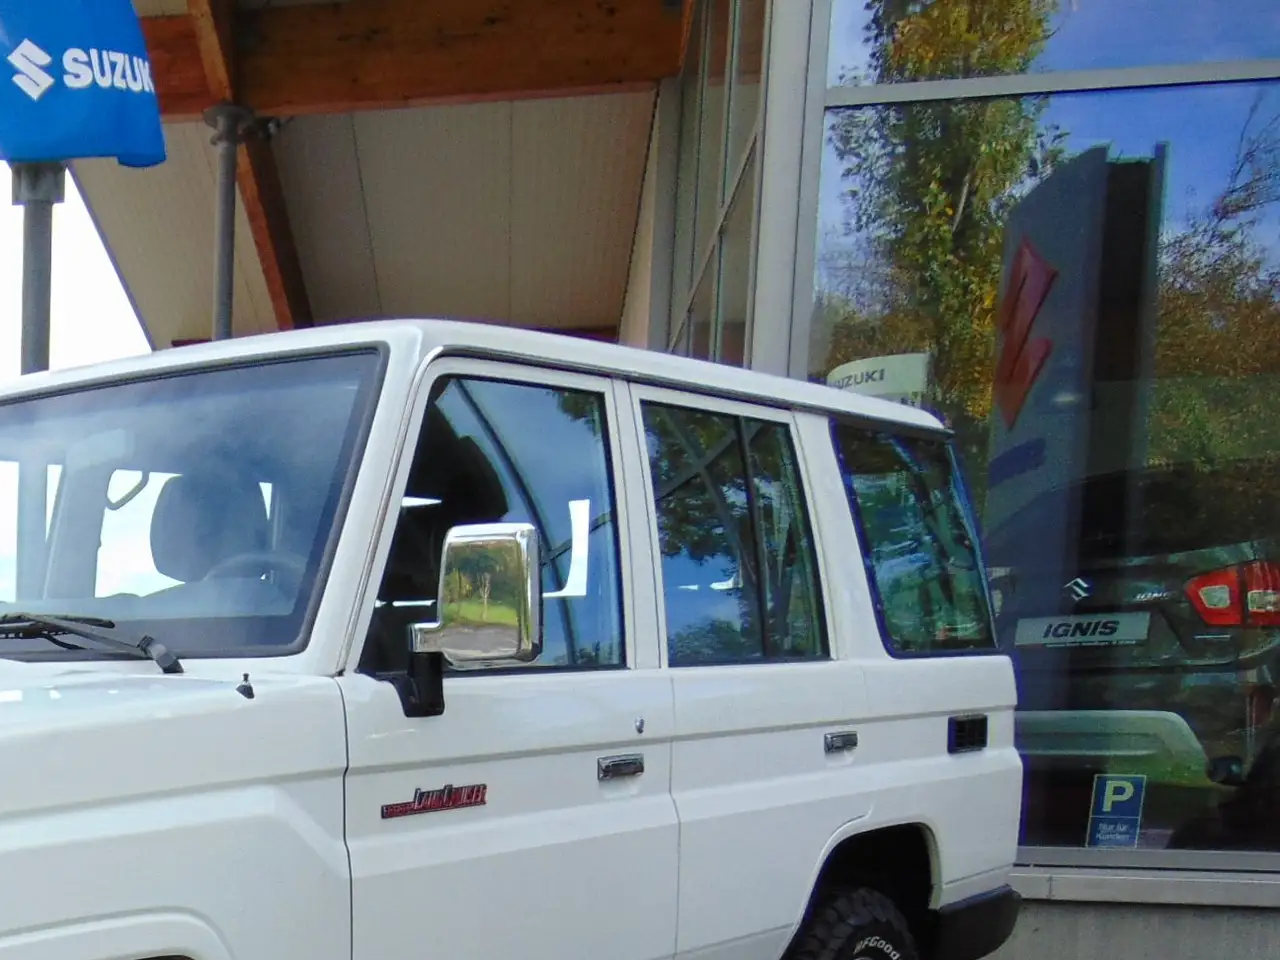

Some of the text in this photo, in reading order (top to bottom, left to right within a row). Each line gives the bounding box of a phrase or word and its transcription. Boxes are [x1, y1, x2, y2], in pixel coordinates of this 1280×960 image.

[832, 368, 886, 389] UZUKI
[1042, 619, 1121, 640] IGNIS
[1102, 780, 1134, 812] P
